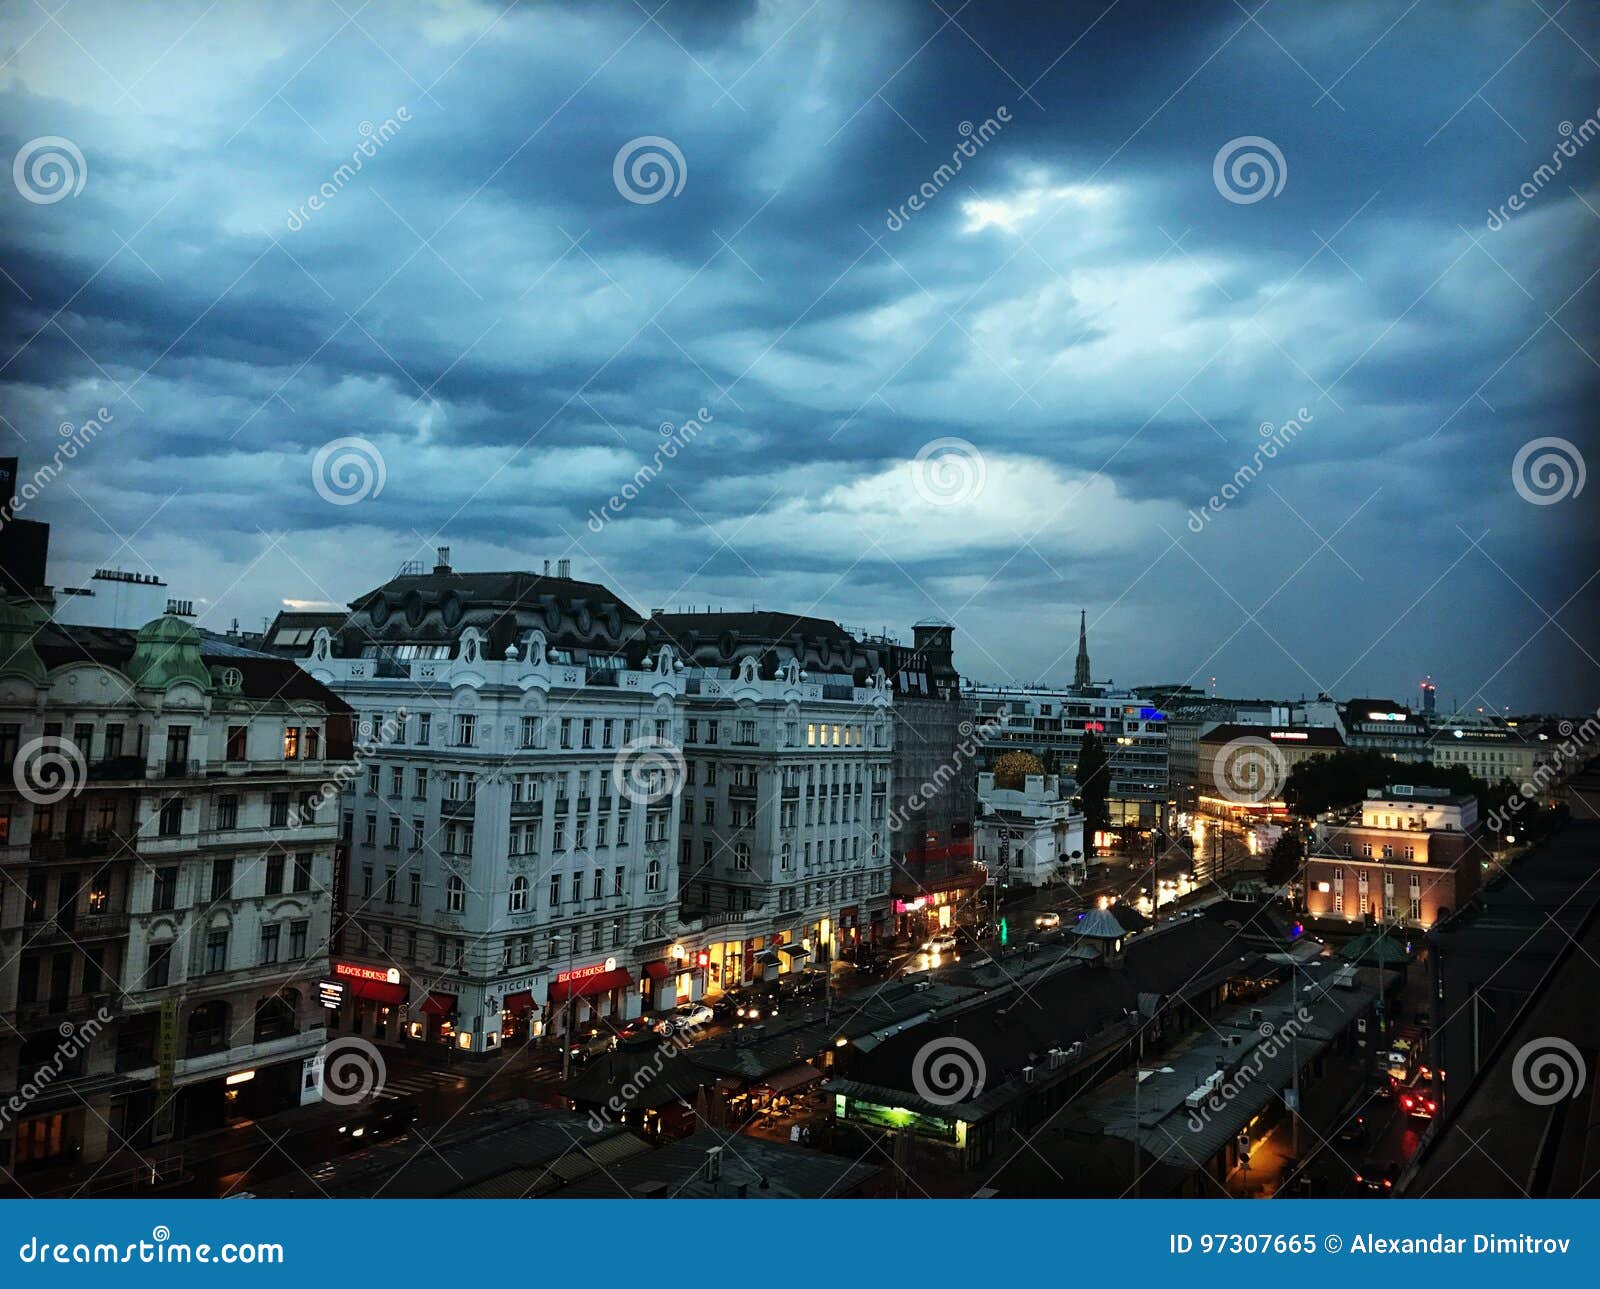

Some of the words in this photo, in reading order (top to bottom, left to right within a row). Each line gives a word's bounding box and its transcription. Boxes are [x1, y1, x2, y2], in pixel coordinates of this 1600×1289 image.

[337, 964, 361, 977] BLOCK
[362, 970, 387, 982] HOUSE
[422, 979, 466, 994] PICCINI
[497, 977, 539, 993] PICCINI
